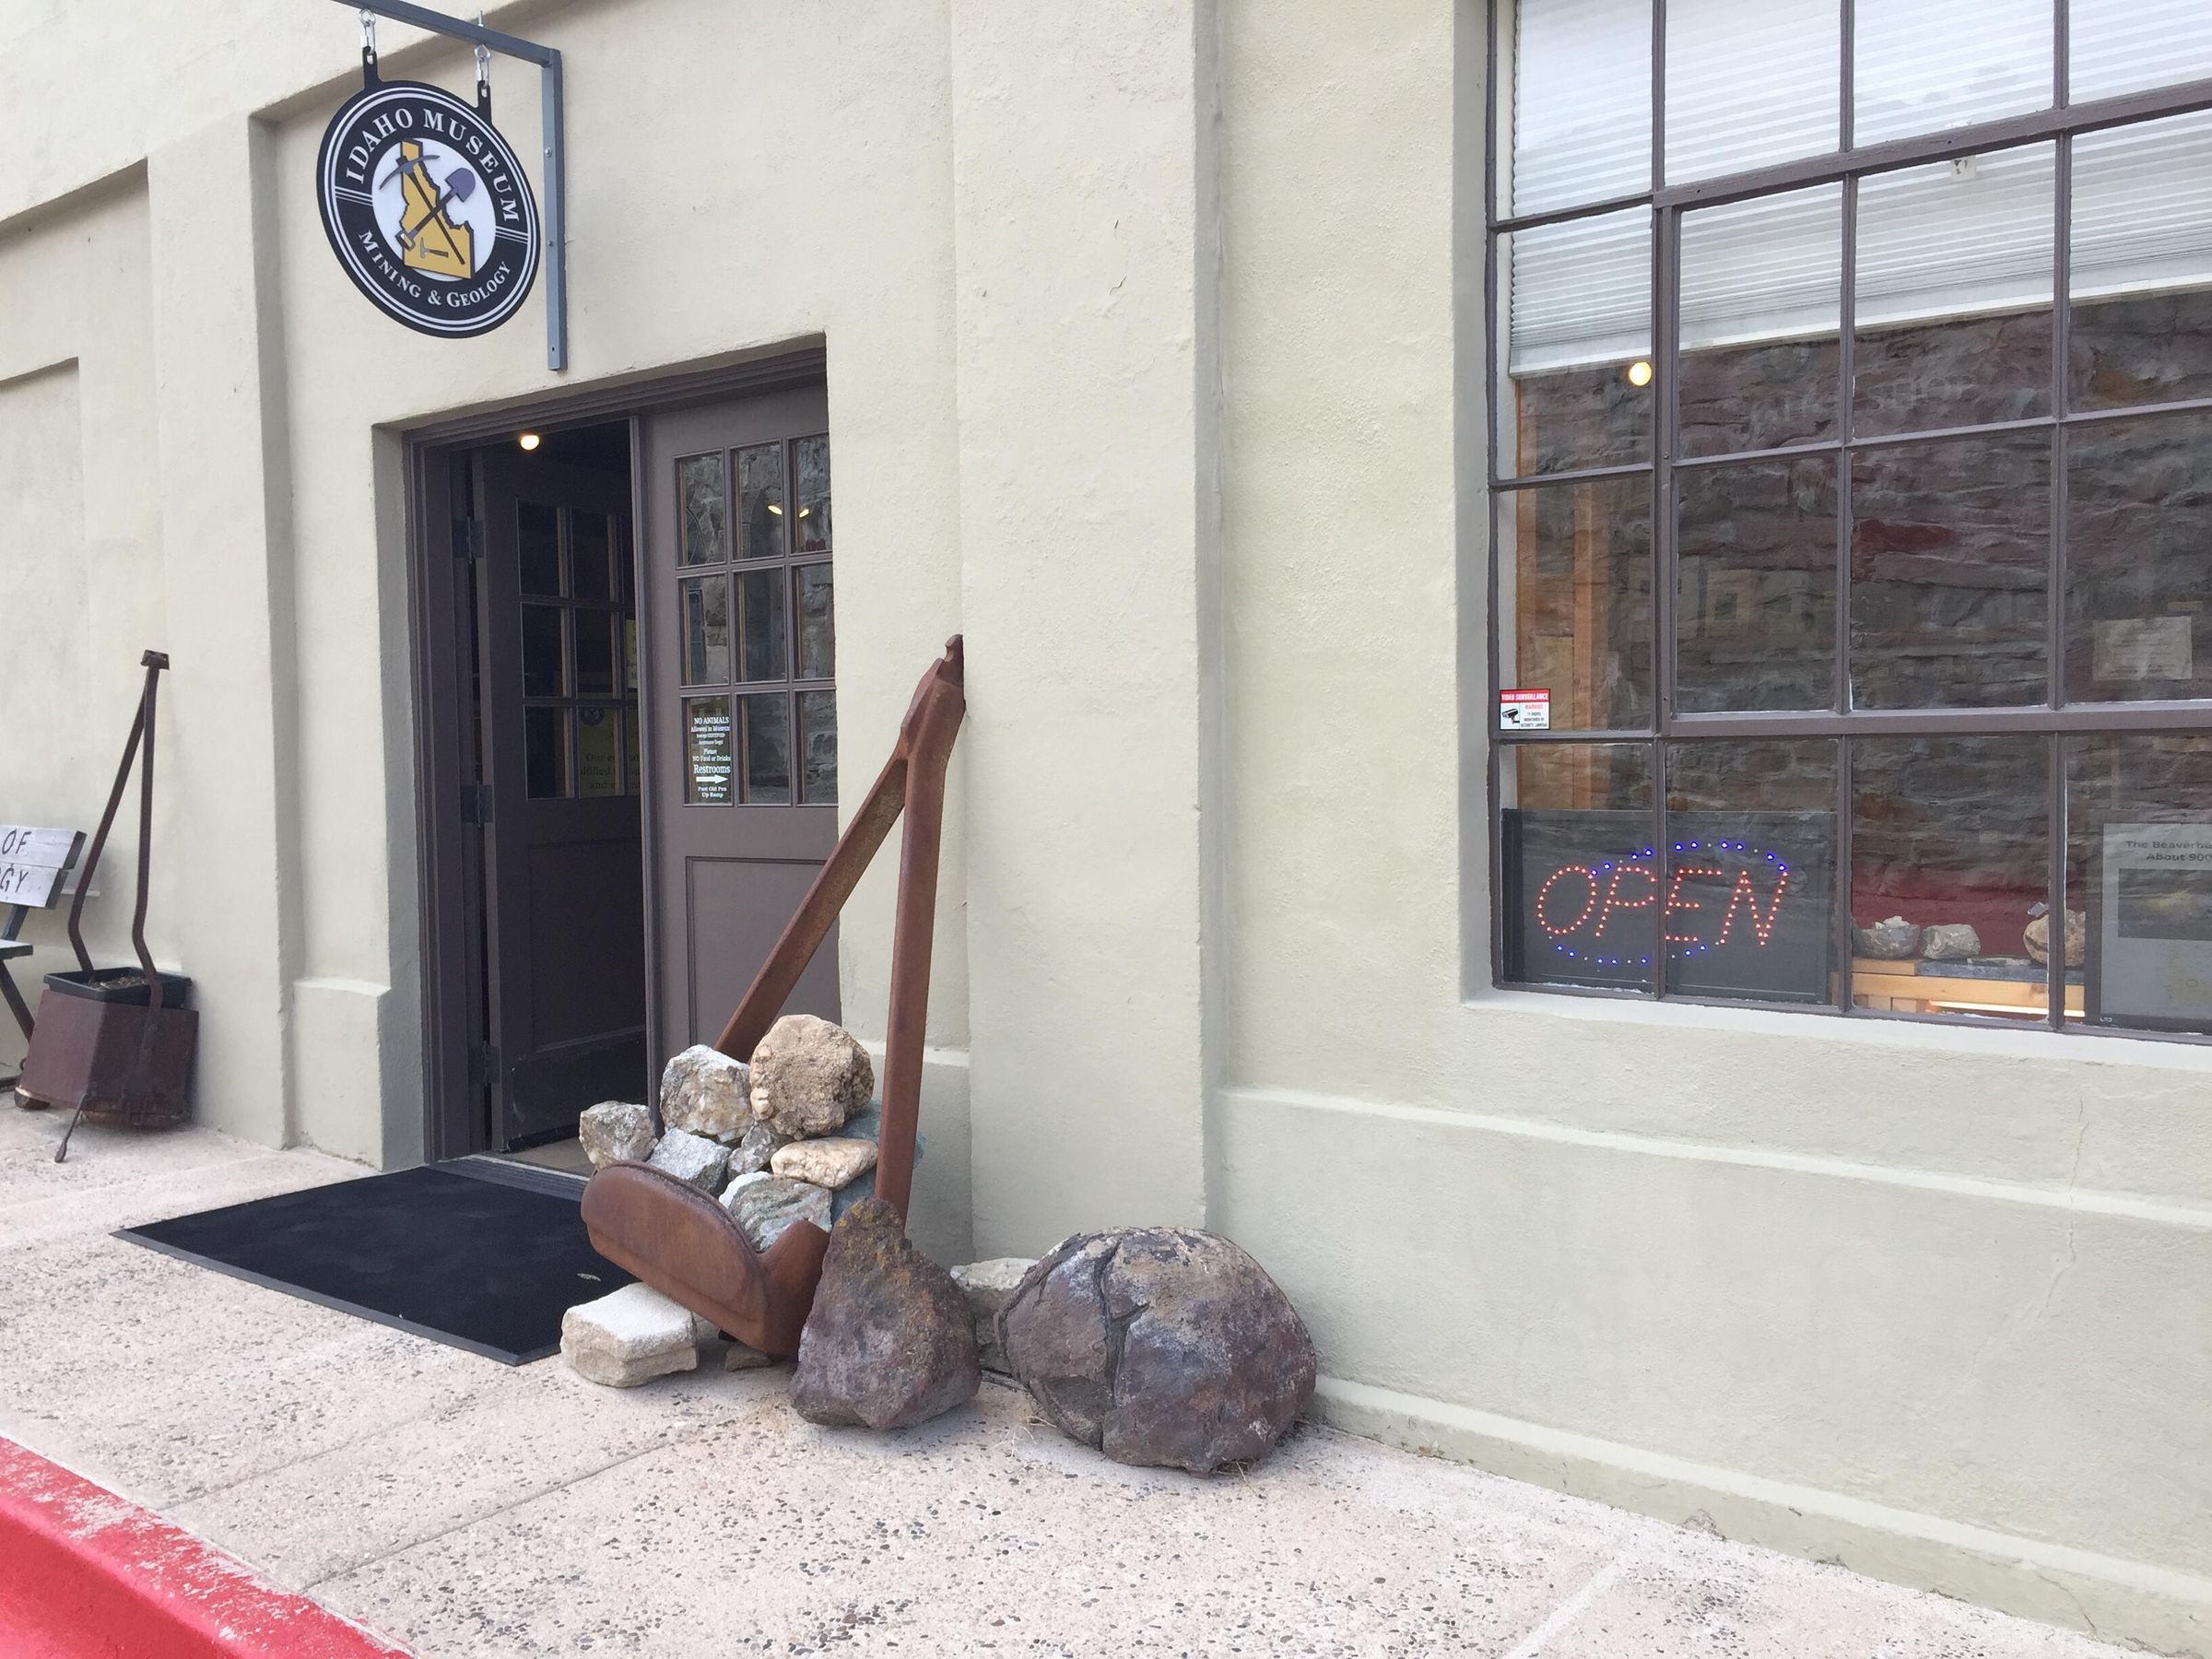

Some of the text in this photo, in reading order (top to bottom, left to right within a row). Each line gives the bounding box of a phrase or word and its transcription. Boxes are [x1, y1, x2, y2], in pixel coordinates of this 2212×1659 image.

[346, 108, 520, 222] IDAHO MUSEUM
[359, 230, 512, 308] MINING & GEOLOGY
[703, 716, 729, 724] ANIMALS
[693, 764, 731, 774] Restrooms
[1, 828, 32, 855] OF
[2125, 840, 2148, 849] The
[2147, 852, 2185, 862] About
[1536, 866, 1790, 946] OPEN
